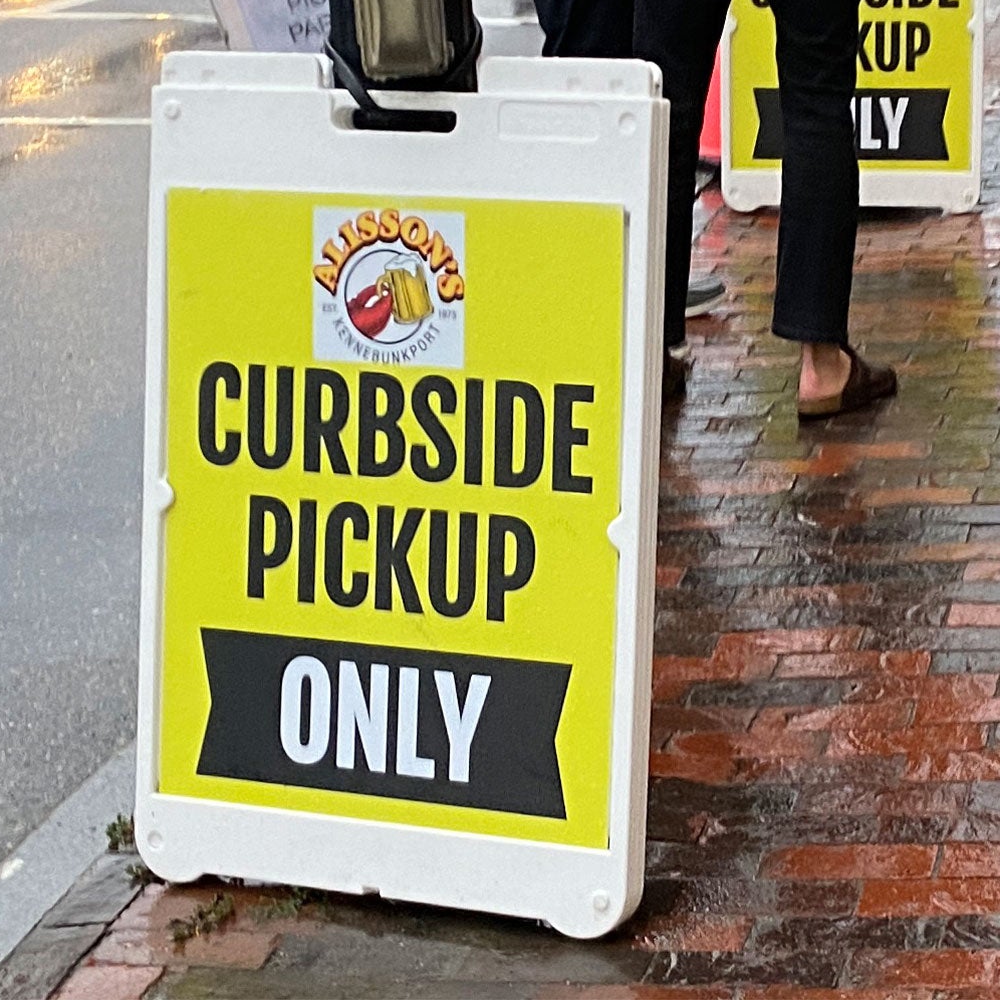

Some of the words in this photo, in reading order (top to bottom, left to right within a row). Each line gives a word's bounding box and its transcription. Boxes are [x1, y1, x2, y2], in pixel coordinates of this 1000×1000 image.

[858, 21, 931, 72] KUP
[313, 208, 465, 304] ALISSON'S
[332, 317, 441, 365] KENNEBUNKPORT
[198, 361, 595, 494] CURBSIDE
[247, 494, 537, 622] PICKUP
[279, 655, 492, 783] ONLY
